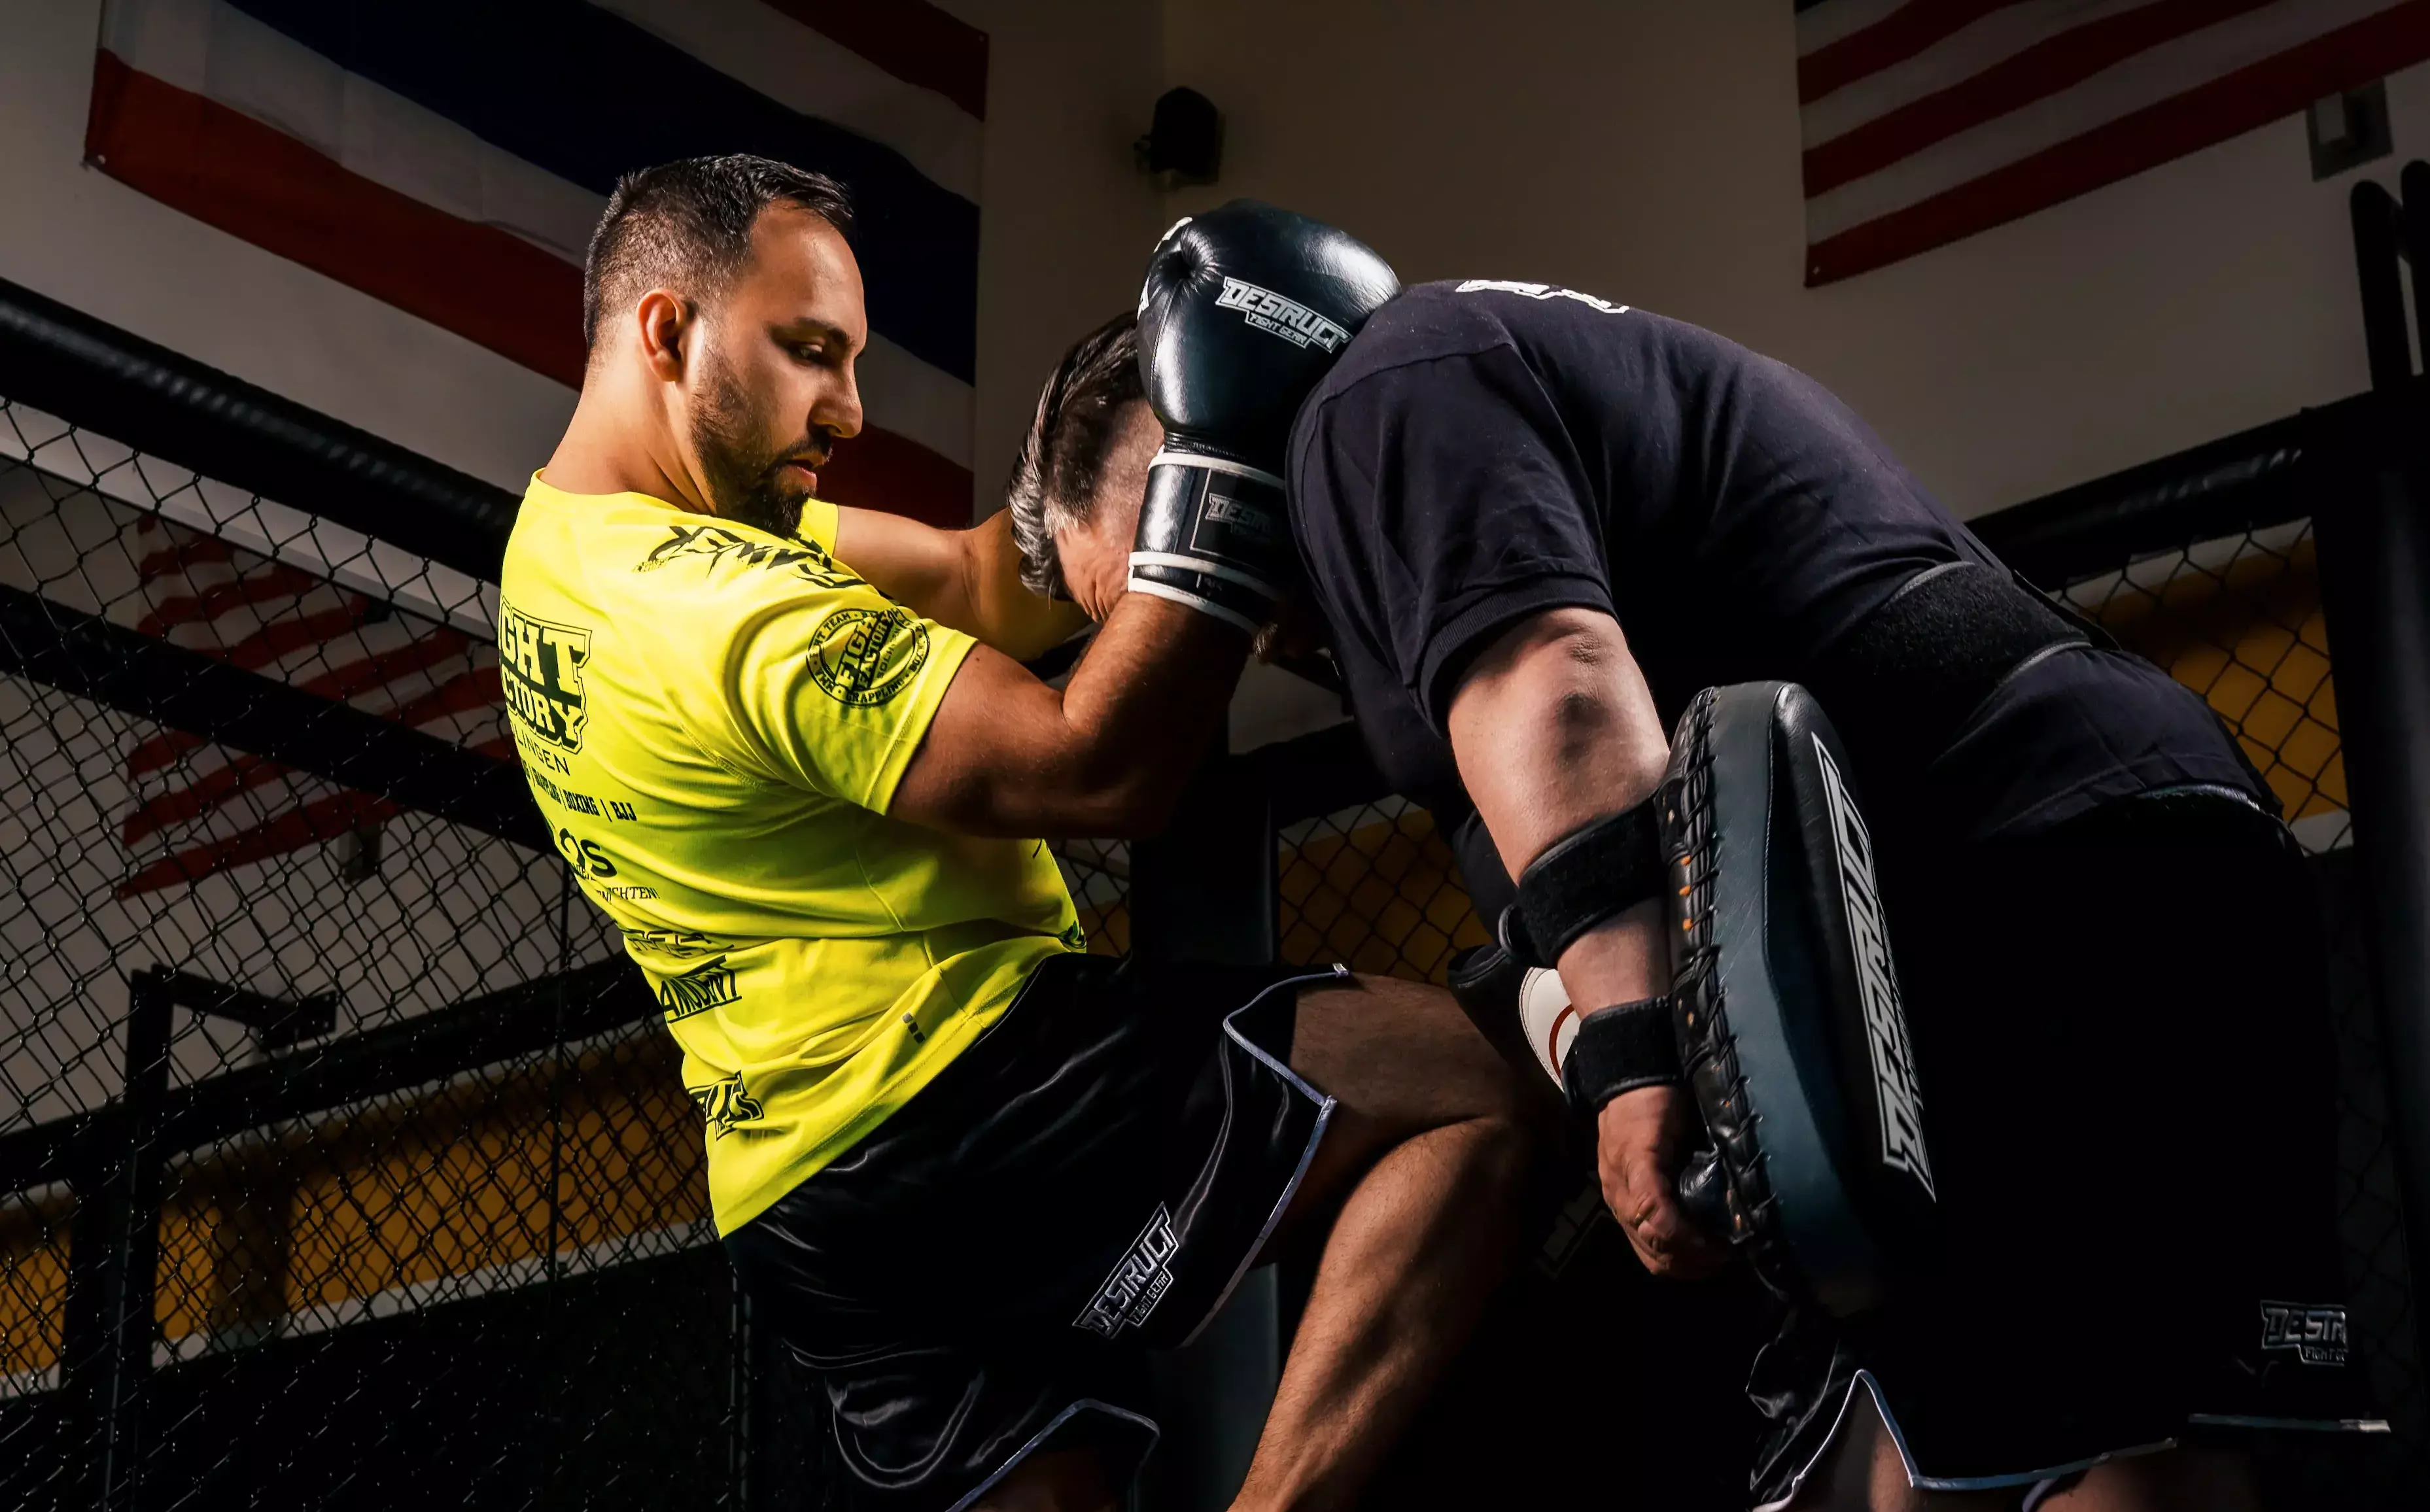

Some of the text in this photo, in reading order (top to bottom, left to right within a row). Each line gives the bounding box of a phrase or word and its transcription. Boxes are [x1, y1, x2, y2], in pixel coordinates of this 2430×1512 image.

[1221, 279, 1352, 348] DESTRUCT
[1249, 314, 1308, 345] FIGHT GEAR
[501, 600, 585, 697] GHT
[824, 612, 852, 631] TEAM
[501, 663, 583, 746] CTORY
[563, 789, 600, 816] BOXING
[609, 800, 638, 822] BJJ
[1823, 755, 1930, 1178] DESTRUCT
[1080, 1213, 1175, 1337] DESTRUCT
